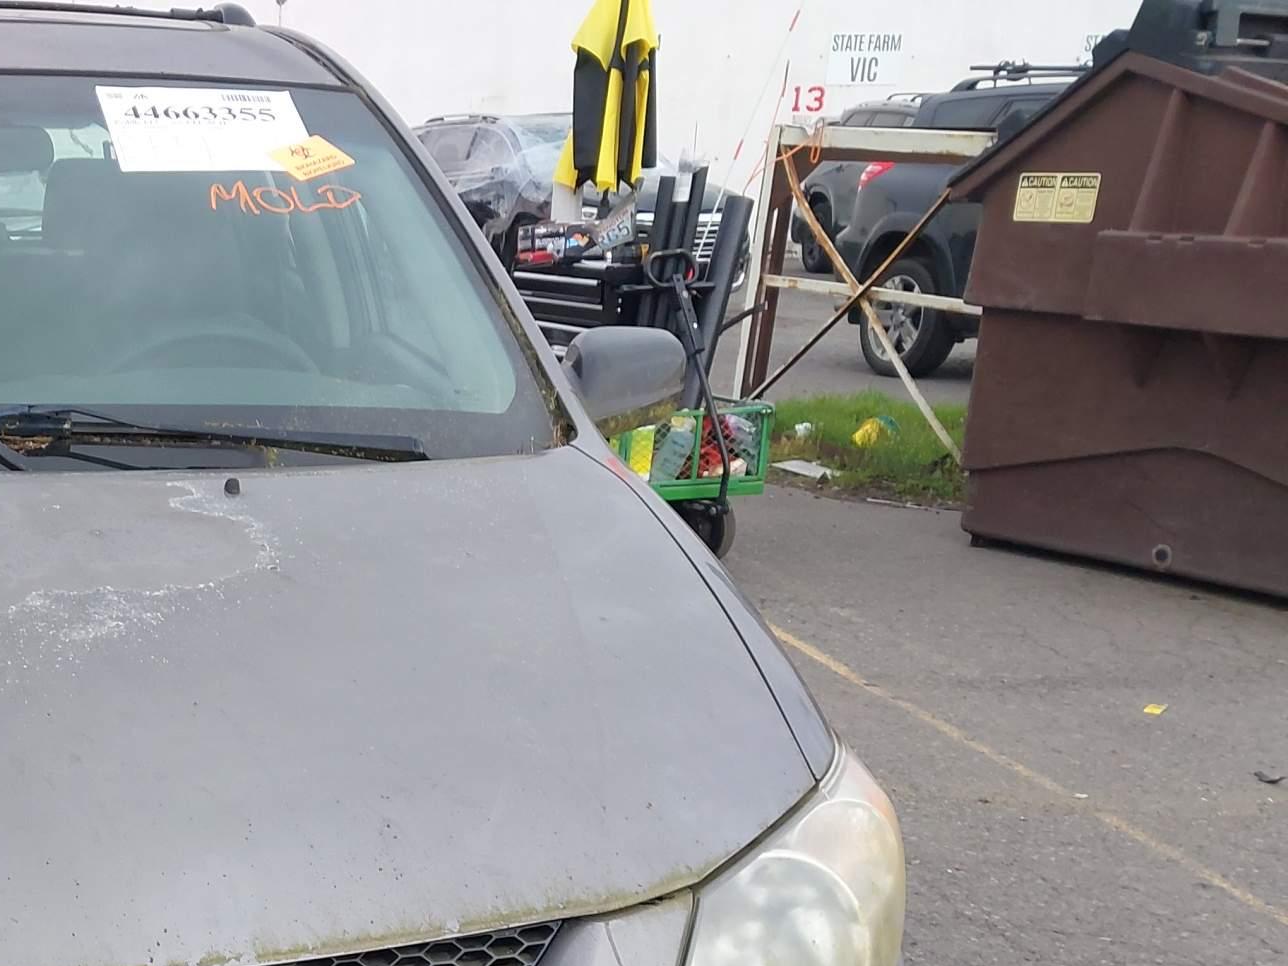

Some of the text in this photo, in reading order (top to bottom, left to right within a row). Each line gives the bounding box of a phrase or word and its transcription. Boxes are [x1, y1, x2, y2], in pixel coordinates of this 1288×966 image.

[832, 33, 902, 52] STATE FARM
[850, 56, 879, 82] VIC
[792, 86, 825, 112] 13
[124, 104, 277, 122] 44663355
[1028, 176, 1057, 188] CAUTION
[1068, 176, 1097, 188] CAUTION
[210, 180, 361, 215] MOLD
